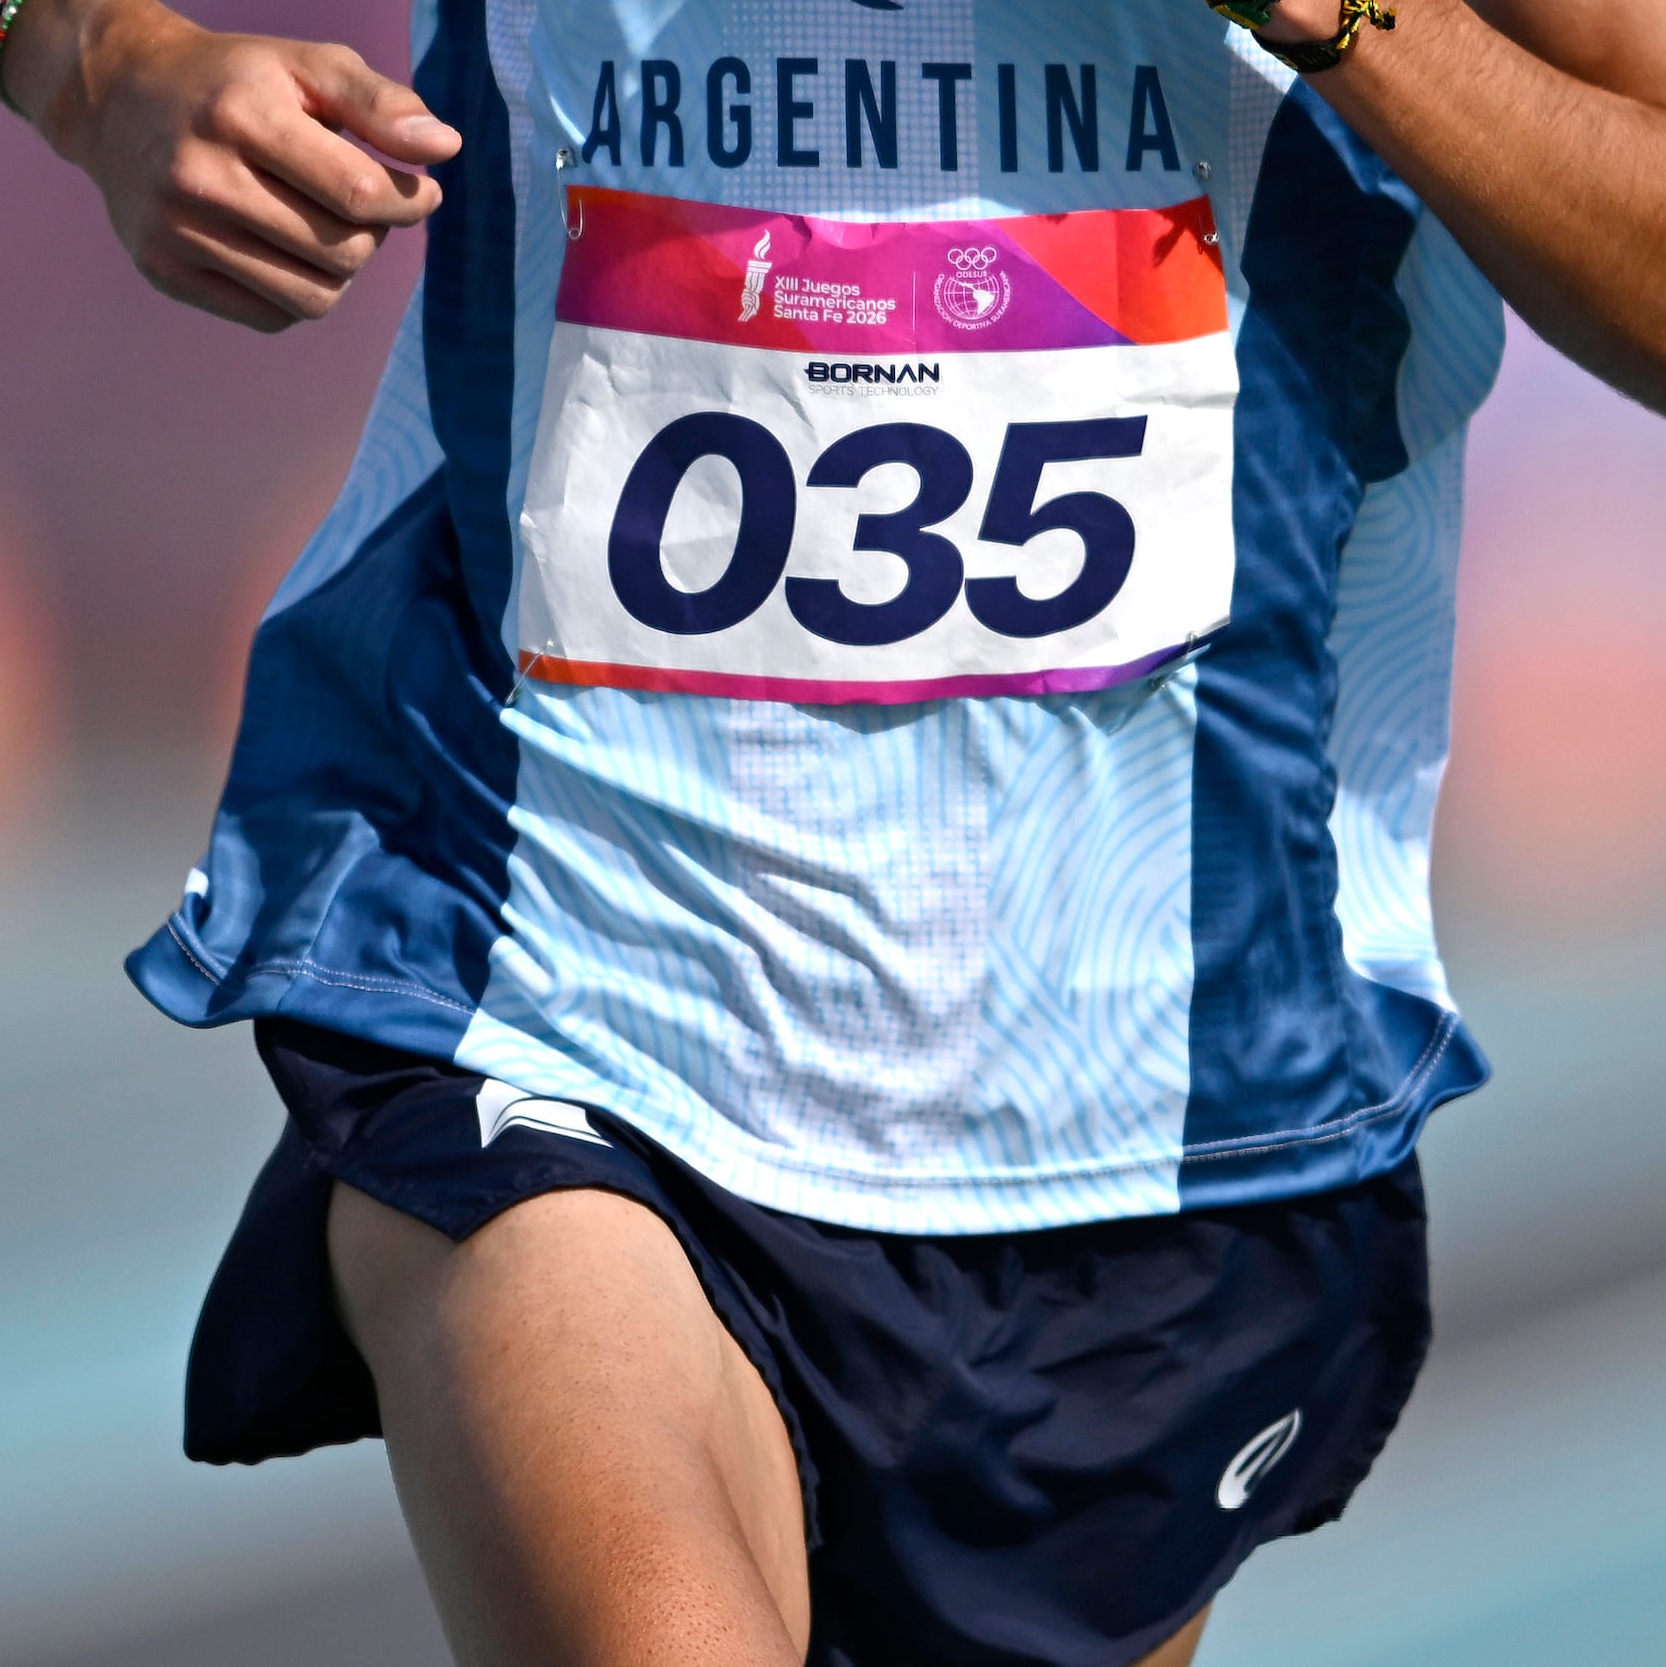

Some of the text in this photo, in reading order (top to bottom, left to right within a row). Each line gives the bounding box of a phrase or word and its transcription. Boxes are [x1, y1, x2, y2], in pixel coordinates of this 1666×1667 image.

[581, 56, 1181, 173] ARGENTINA
[774, 276, 860, 297] XIII Juegos
[773, 290, 896, 310] Suramericanos
[773, 304, 887, 325] Santa Fe 2026
[803, 361, 940, 384] BORNAN
[808, 384, 940, 397] SPORTS TECHNOLOGY
[608, 411, 1148, 646] 035
